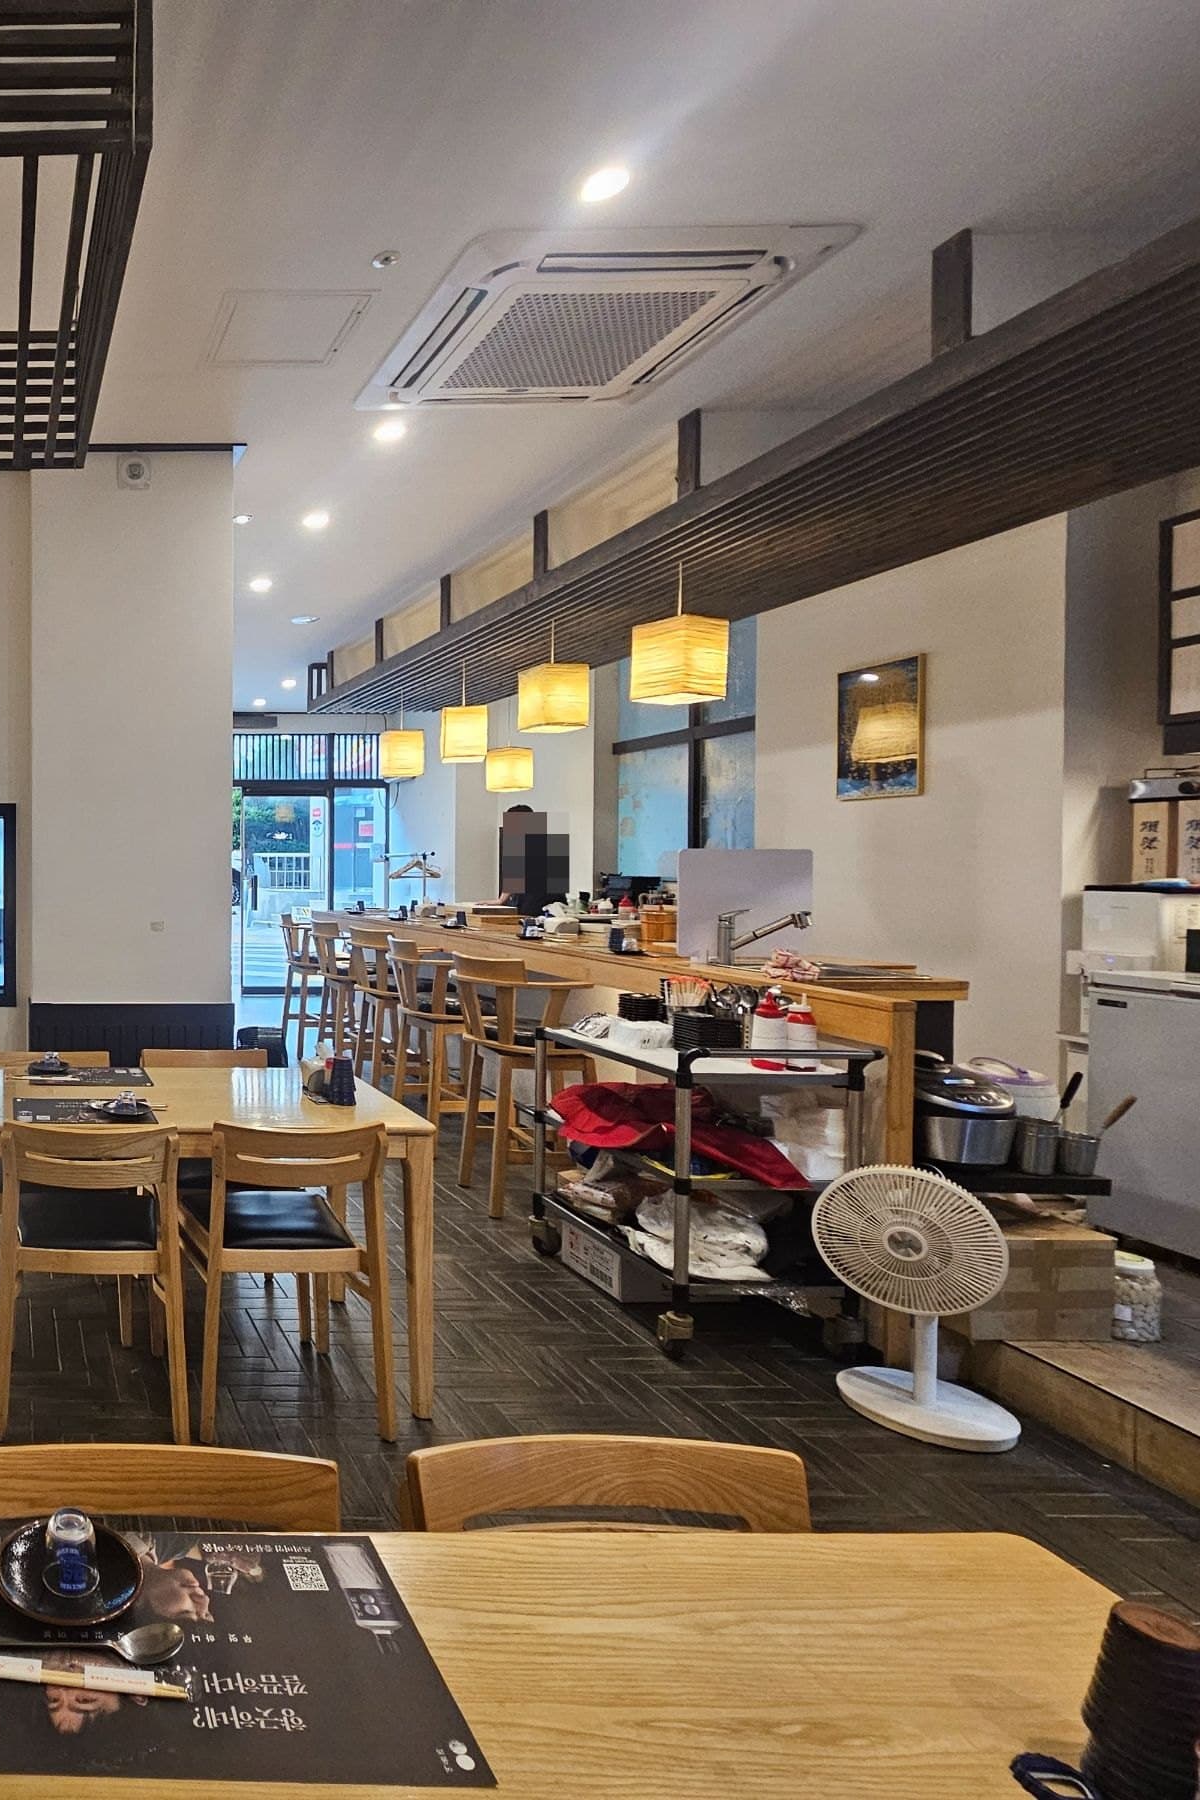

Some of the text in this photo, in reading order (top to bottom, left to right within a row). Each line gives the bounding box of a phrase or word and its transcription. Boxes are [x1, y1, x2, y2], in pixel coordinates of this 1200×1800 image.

[190, 1633, 216, 1644] 하나
[227, 1633, 253, 1644] 무엇
[202, 1671, 309, 1697] 깔끔하다!
[191, 1704, 308, 1732] 향긋하네?
